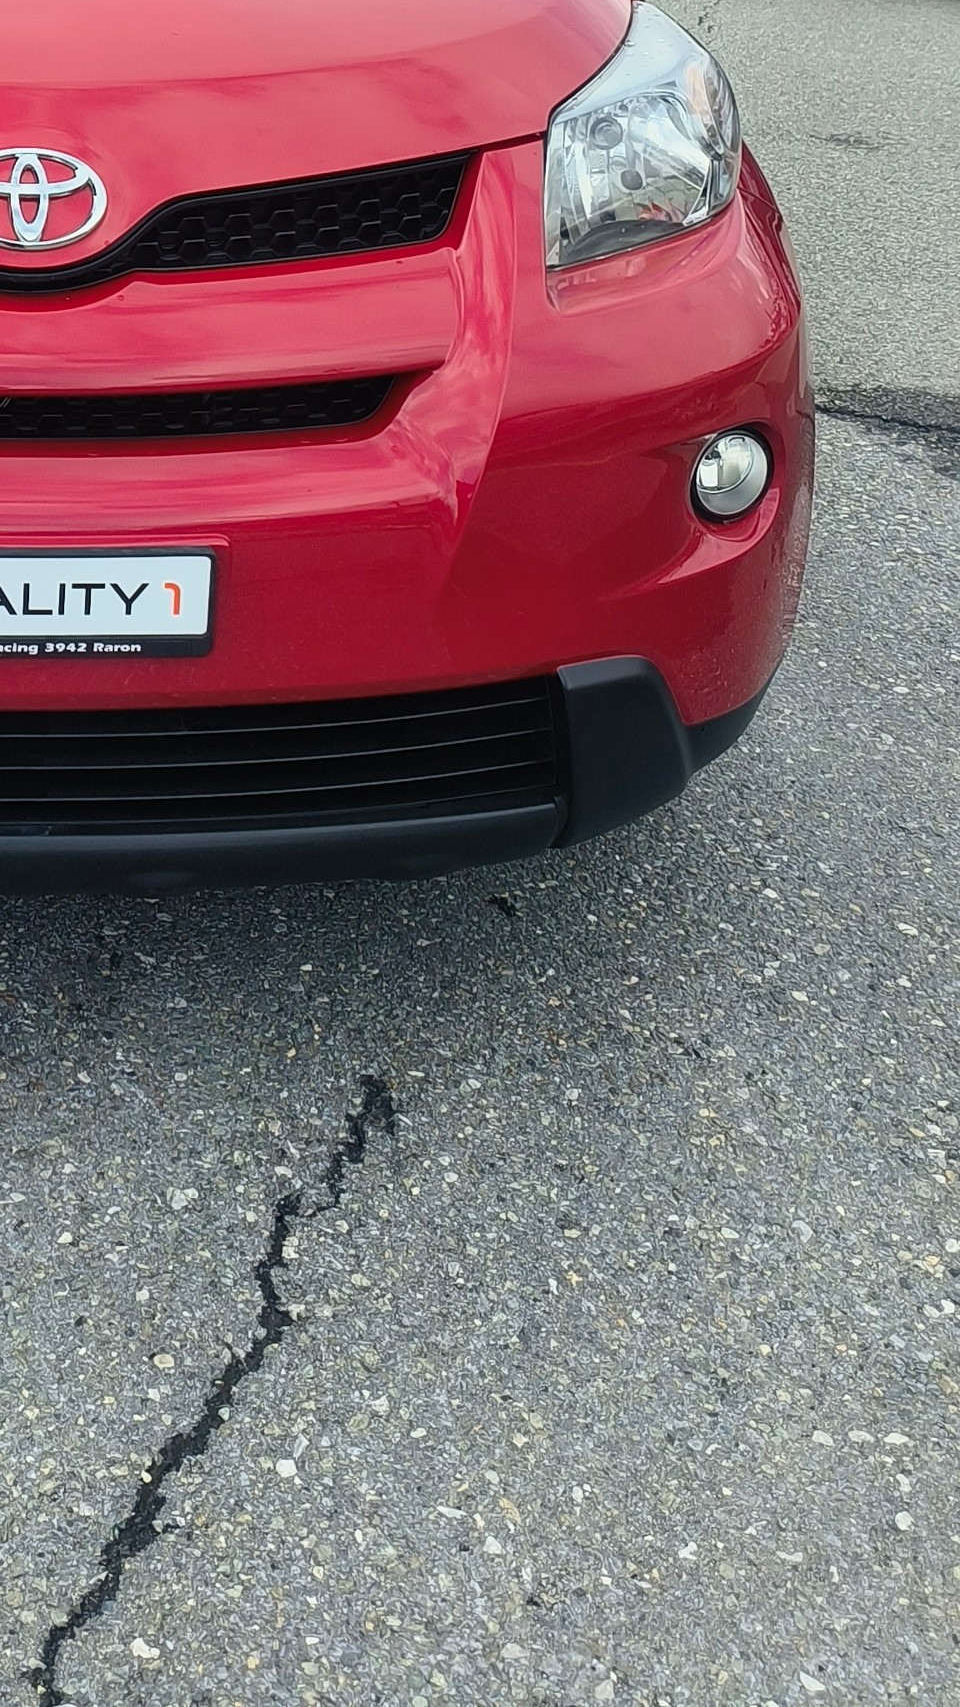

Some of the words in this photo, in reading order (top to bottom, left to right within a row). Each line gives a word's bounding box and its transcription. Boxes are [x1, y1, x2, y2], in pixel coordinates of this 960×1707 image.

[164, 582, 182, 615] 1
[44, 642, 87, 653] 3942
[92, 642, 142, 653] Raron
